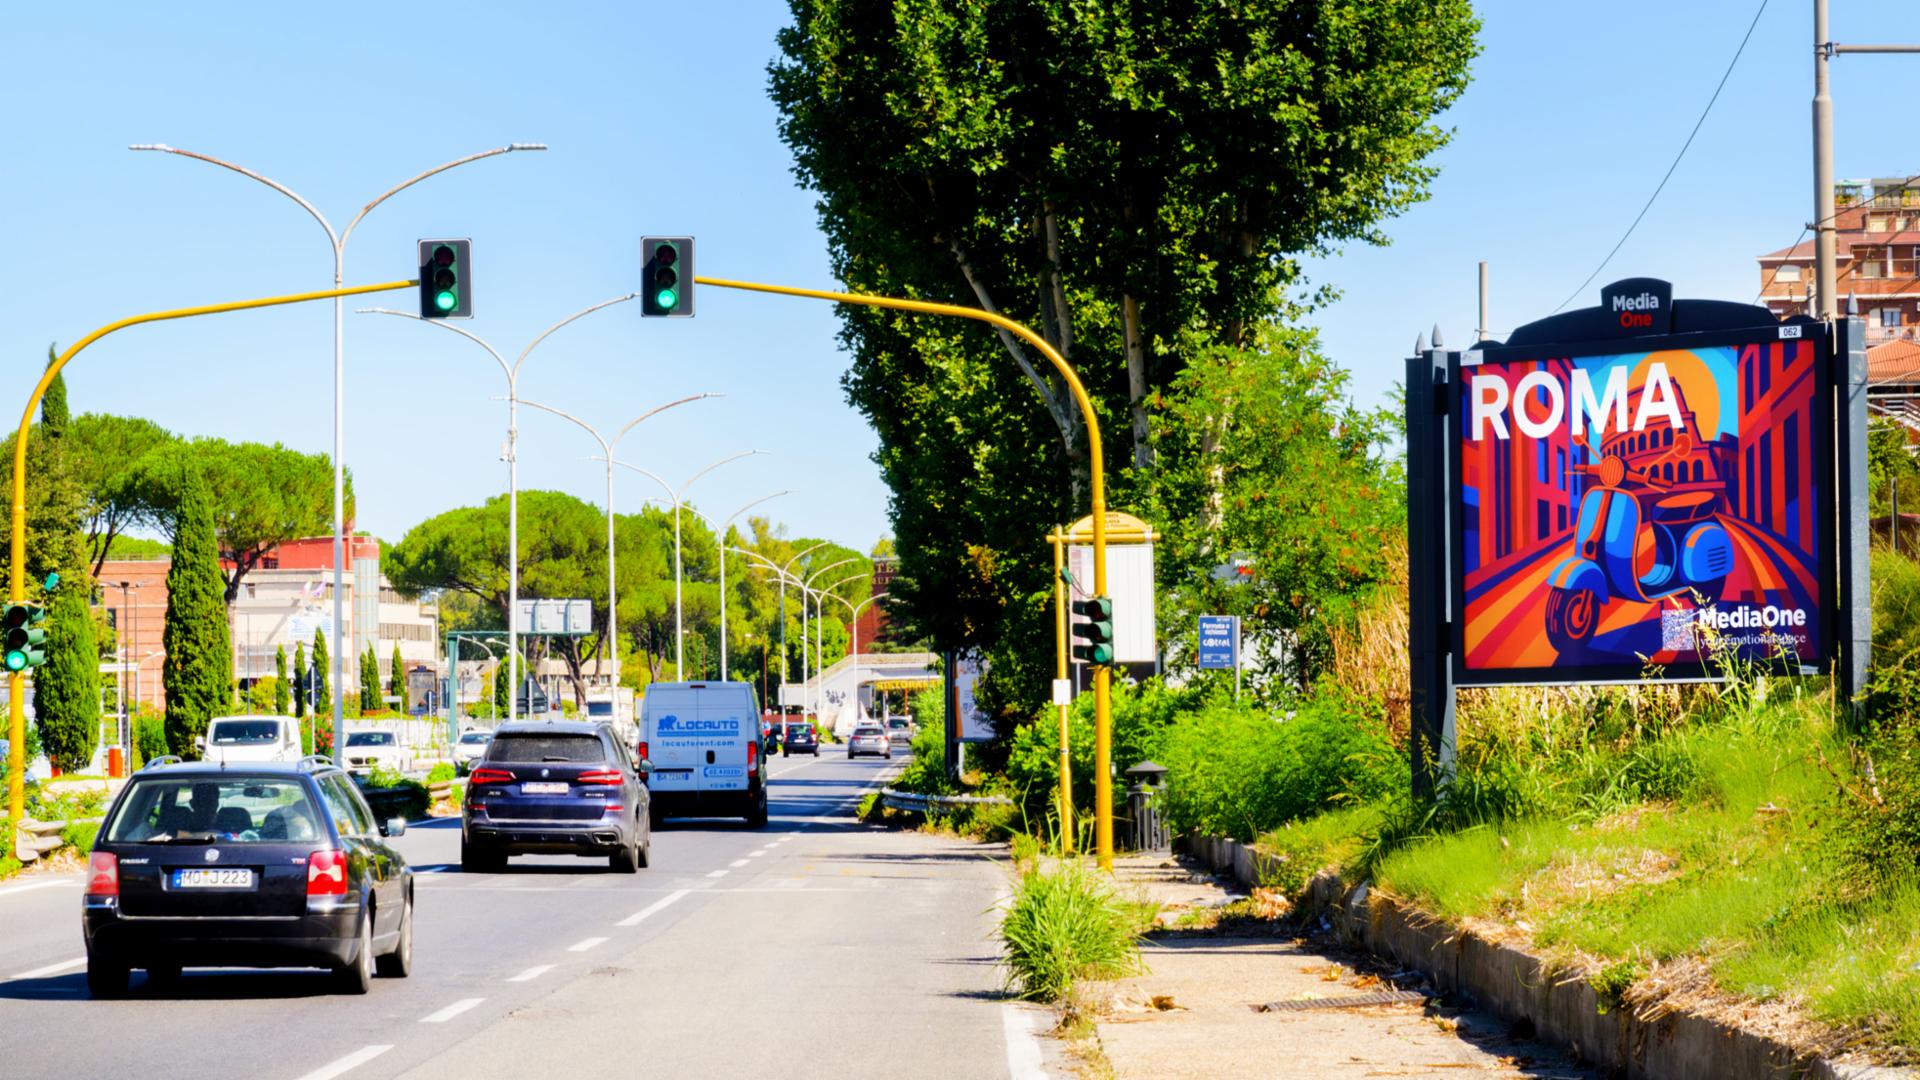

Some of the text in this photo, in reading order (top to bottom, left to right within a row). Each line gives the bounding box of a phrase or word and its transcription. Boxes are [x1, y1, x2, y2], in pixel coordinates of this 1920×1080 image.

[1612, 294, 1659, 311] Media
[1619, 312, 1652, 328] One
[1783, 328, 1798, 337] 062
[1471, 362, 1684, 441] ROMA
[1699, 605, 1806, 629] MediaOne
[677, 720, 739, 729] LOCAUTO
[661, 739, 735, 747] locautorent.com
